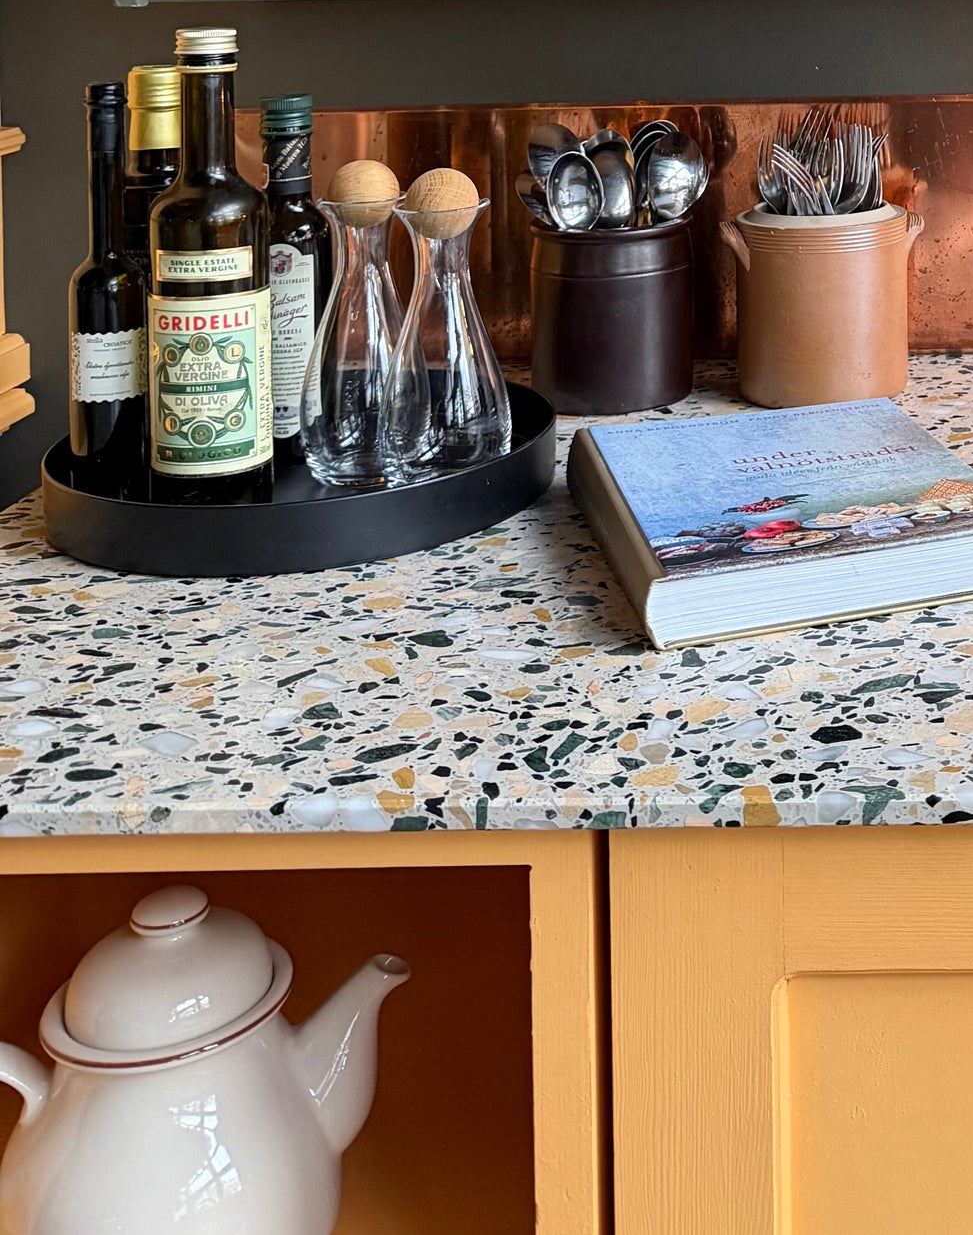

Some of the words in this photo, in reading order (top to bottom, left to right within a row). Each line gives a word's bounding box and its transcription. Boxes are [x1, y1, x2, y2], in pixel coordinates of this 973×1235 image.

[170, 259, 202, 267] SINGLE
[204, 257, 236, 266] ESTATE
[198, 264, 240, 274] VERGINE
[158, 310, 249, 332] GRIDELLI
[275, 341, 307, 349] BALSAMICO
[180, 361, 222, 372] EXTRA
[174, 370, 229, 382] VERGINE
[186, 384, 217, 393] RIMINI
[175, 397, 186, 407] DI
[190, 395, 228, 407] OLIVA
[748, 413, 789, 422] FANNY
[731, 450, 817, 465] under
[736, 445, 917, 474] valnötsträdet
